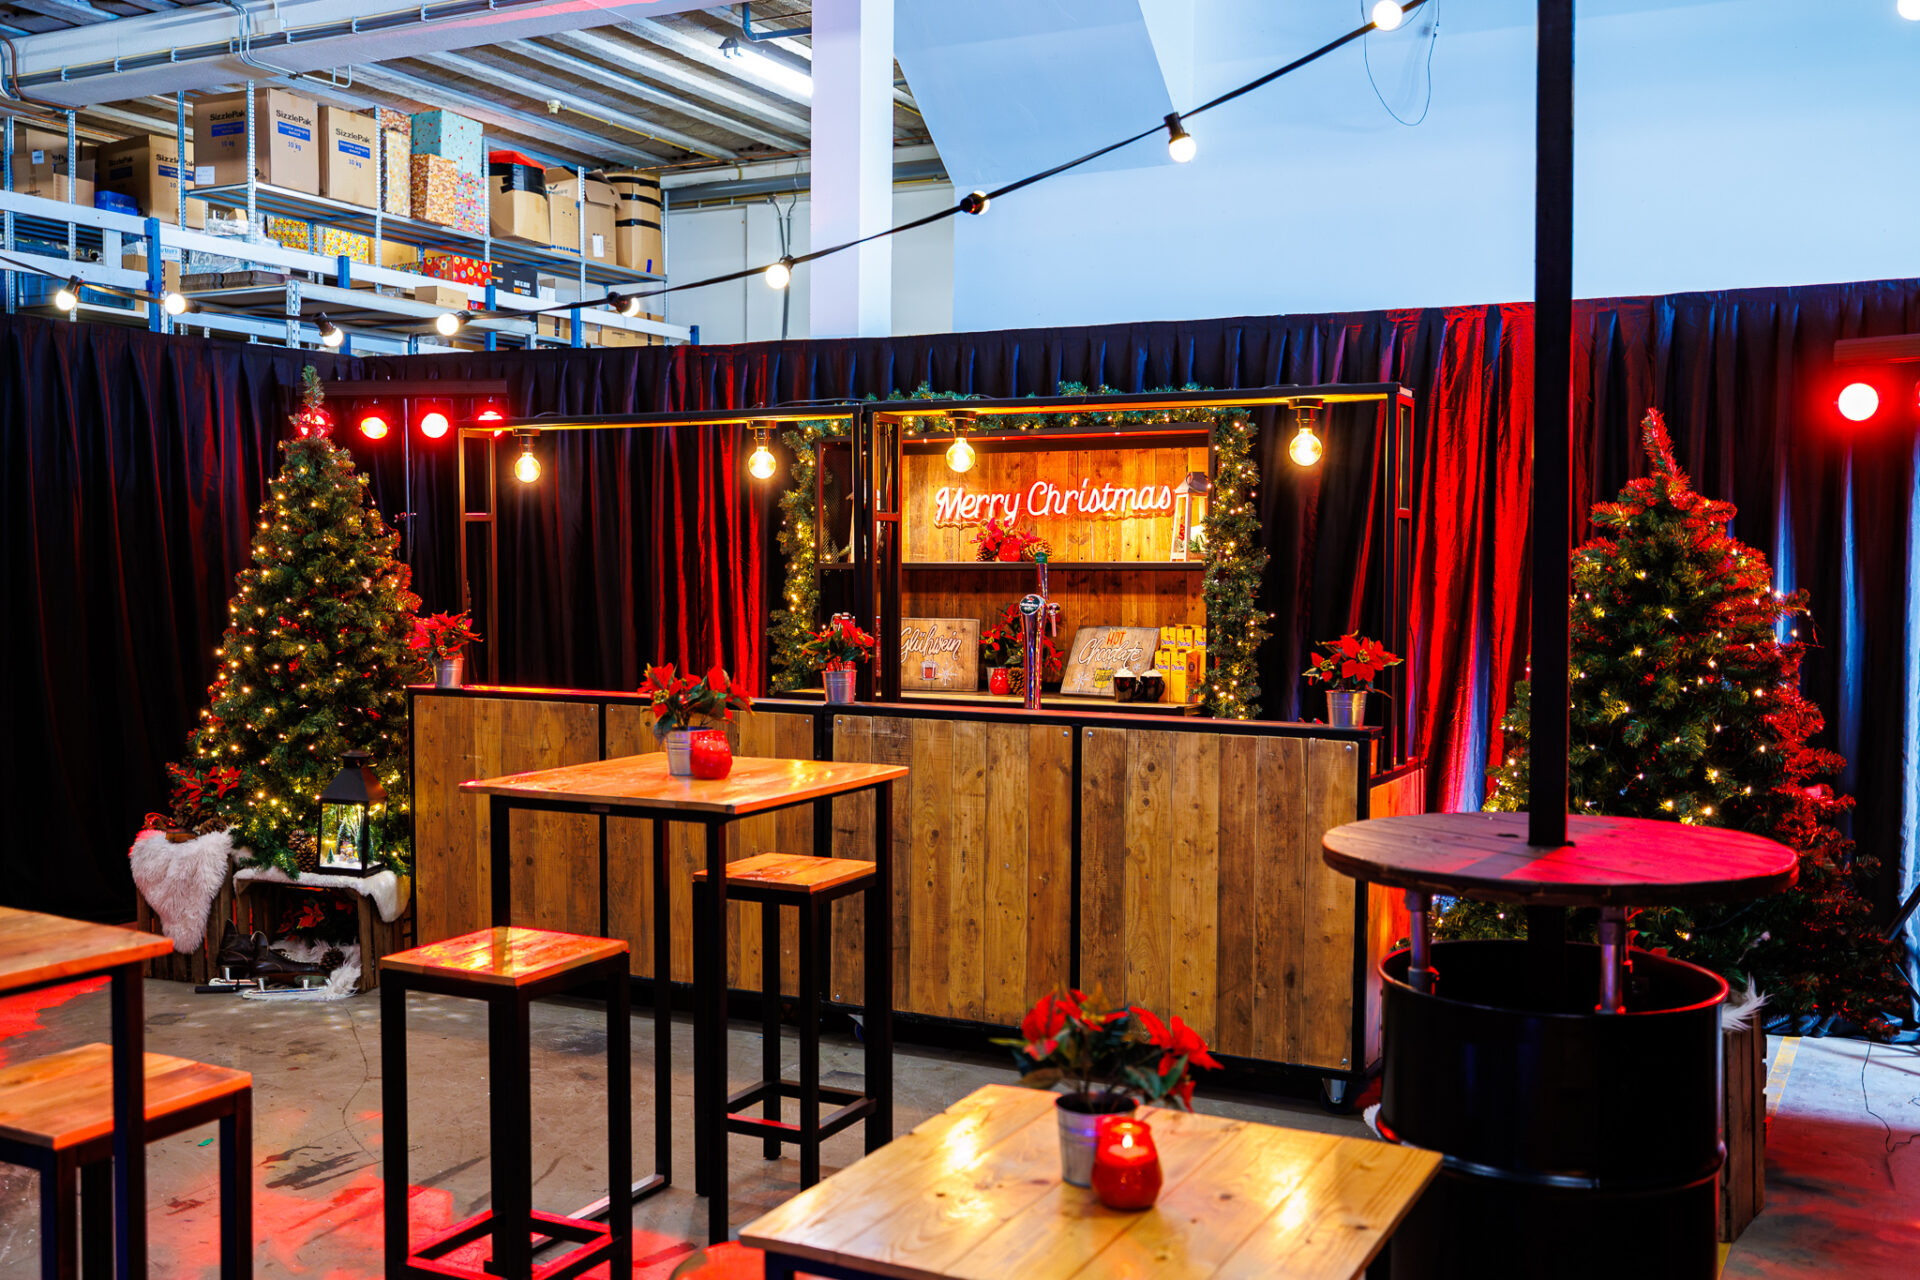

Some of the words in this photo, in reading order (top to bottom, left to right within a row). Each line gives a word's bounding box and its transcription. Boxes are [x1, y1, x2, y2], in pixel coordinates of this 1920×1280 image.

[209, 110, 246, 121] SizzlePak
[275, 109, 312, 126] SizzlePak
[335, 127, 371, 144] SizzlePak
[295, 143, 302, 152] kg
[348, 158, 355, 166] 10
[355, 159, 362, 169] kg
[935, 486, 1021, 527] Merry
[1027, 478, 1172, 517] Christmas
[1106, 630, 1127, 646] HOT
[1078, 637, 1144, 669] Chocolate
